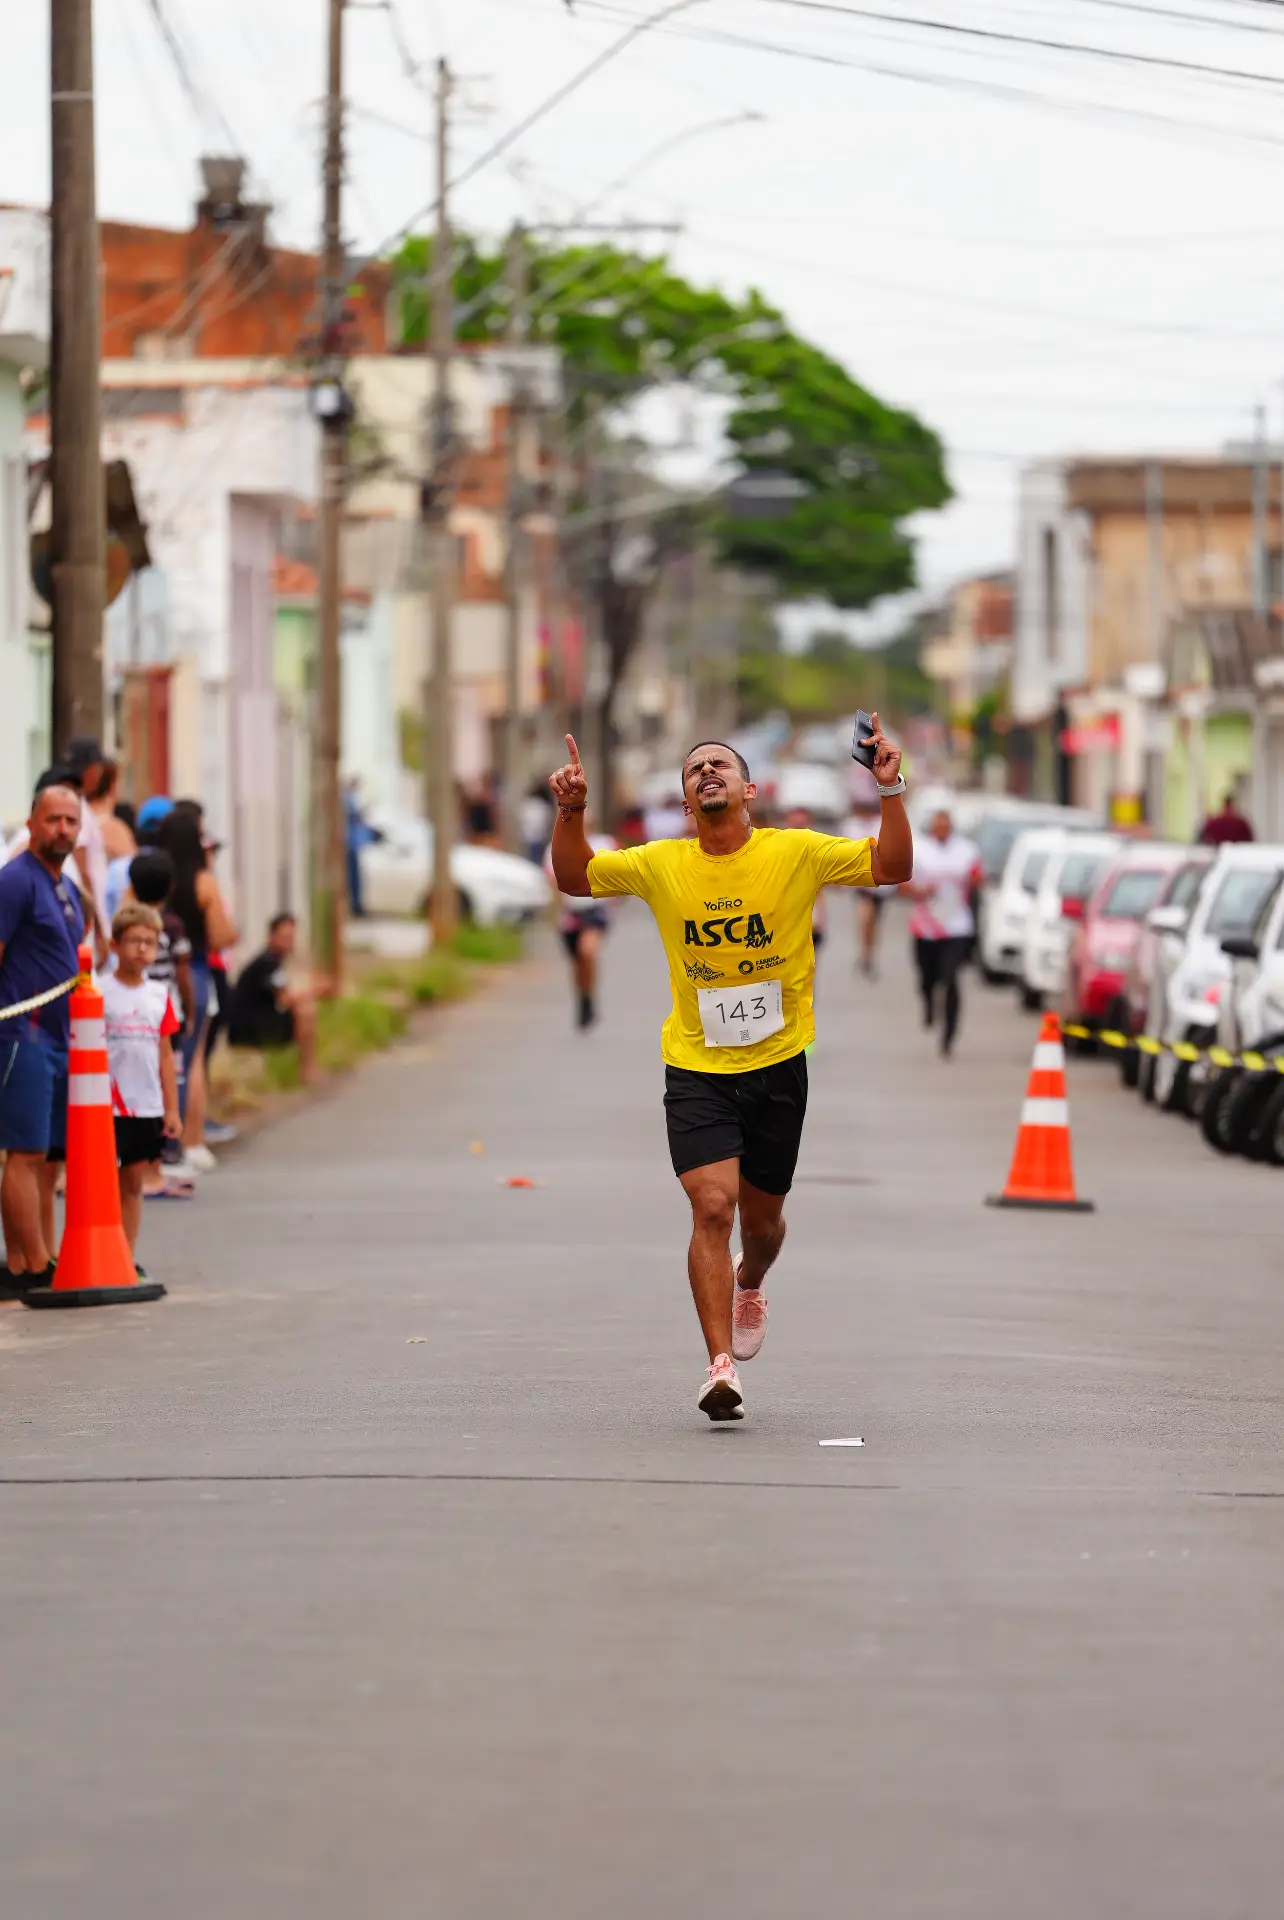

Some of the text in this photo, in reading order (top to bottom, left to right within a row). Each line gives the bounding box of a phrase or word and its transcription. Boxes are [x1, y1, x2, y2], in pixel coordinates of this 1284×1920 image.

[703, 898, 743, 911] YoPRO
[684, 912, 767, 947] ASCA
[743, 929, 774, 950] RUN
[715, 996, 767, 1024] 143
